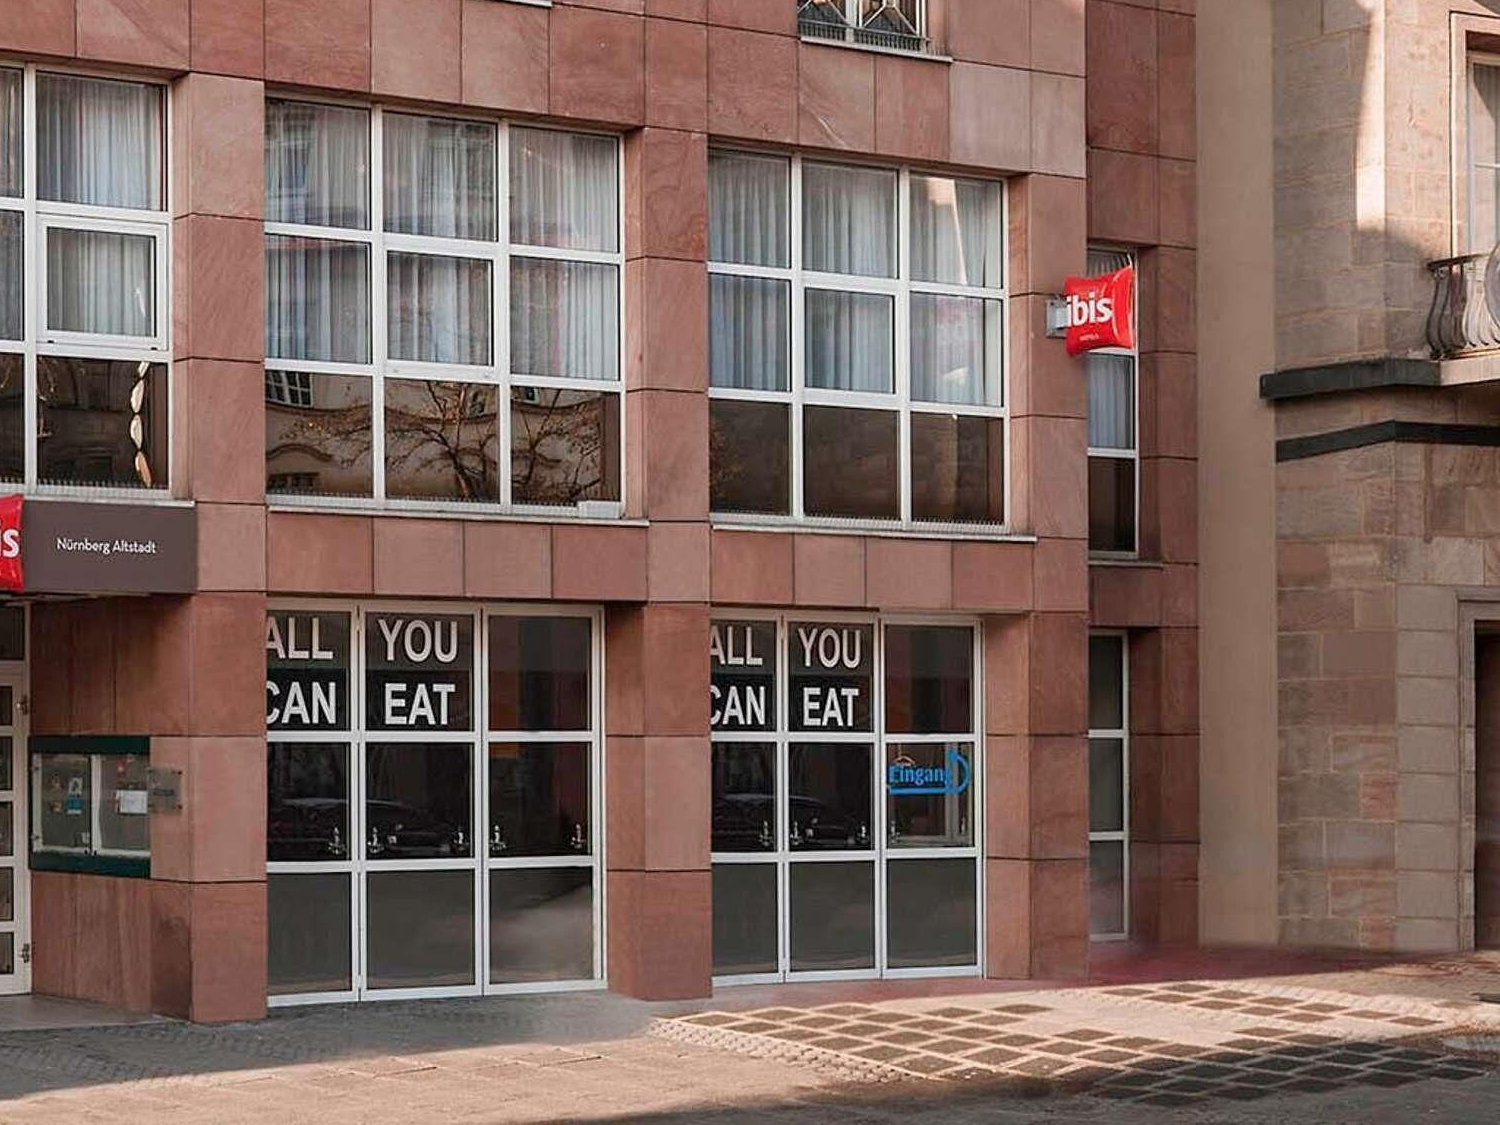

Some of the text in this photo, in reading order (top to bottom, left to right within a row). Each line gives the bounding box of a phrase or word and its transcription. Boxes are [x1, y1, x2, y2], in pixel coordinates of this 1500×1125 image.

[1066, 291, 1113, 329] ibis
[56, 537, 158, 555] Nürnberg Altstadt
[266, 617, 458, 663] ALL YOU
[711, 625, 861, 668] ALL YOU
[385, 682, 456, 726] EAT
[803, 686, 860, 727] EAT
